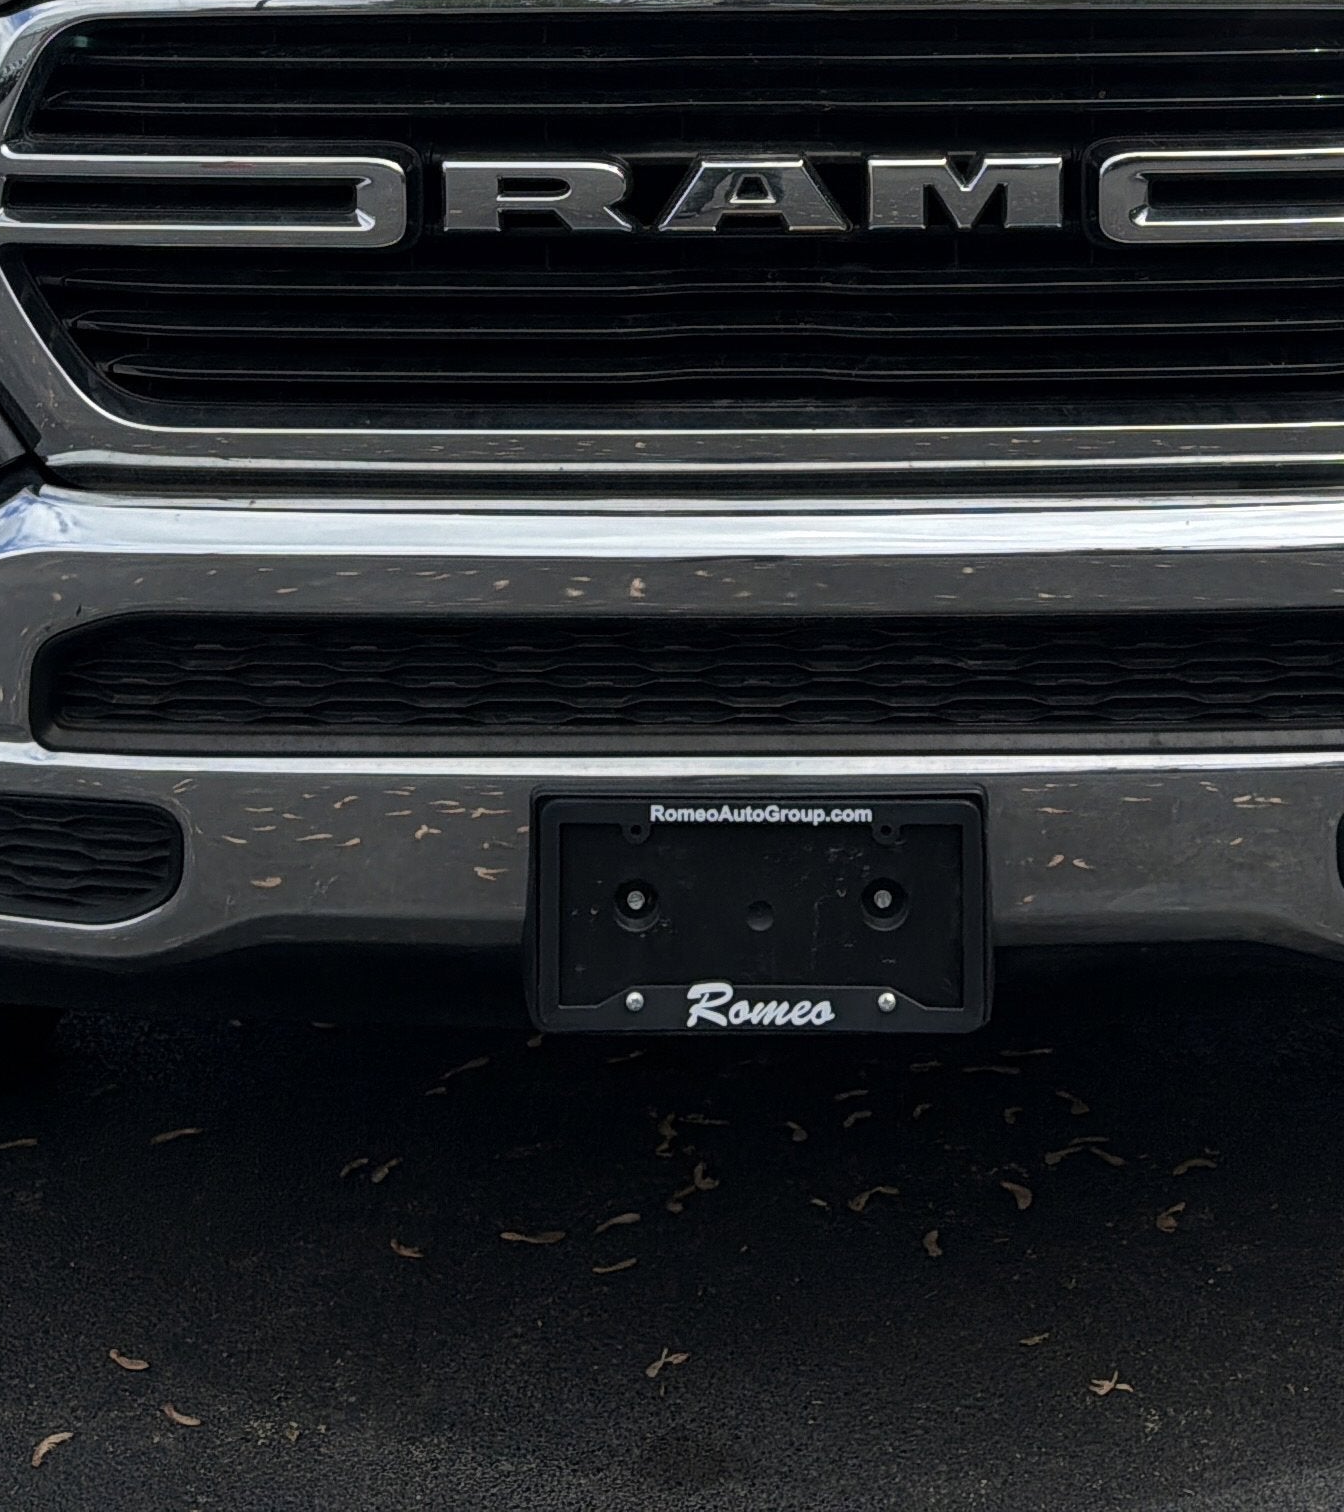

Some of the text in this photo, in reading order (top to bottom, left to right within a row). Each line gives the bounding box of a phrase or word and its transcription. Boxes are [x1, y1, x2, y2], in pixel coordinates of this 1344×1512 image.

[442, 154, 1063, 232] RAM
[650, 805, 873, 826] RomeoAutoGroup.com
[686, 982, 836, 1028] Romeo
